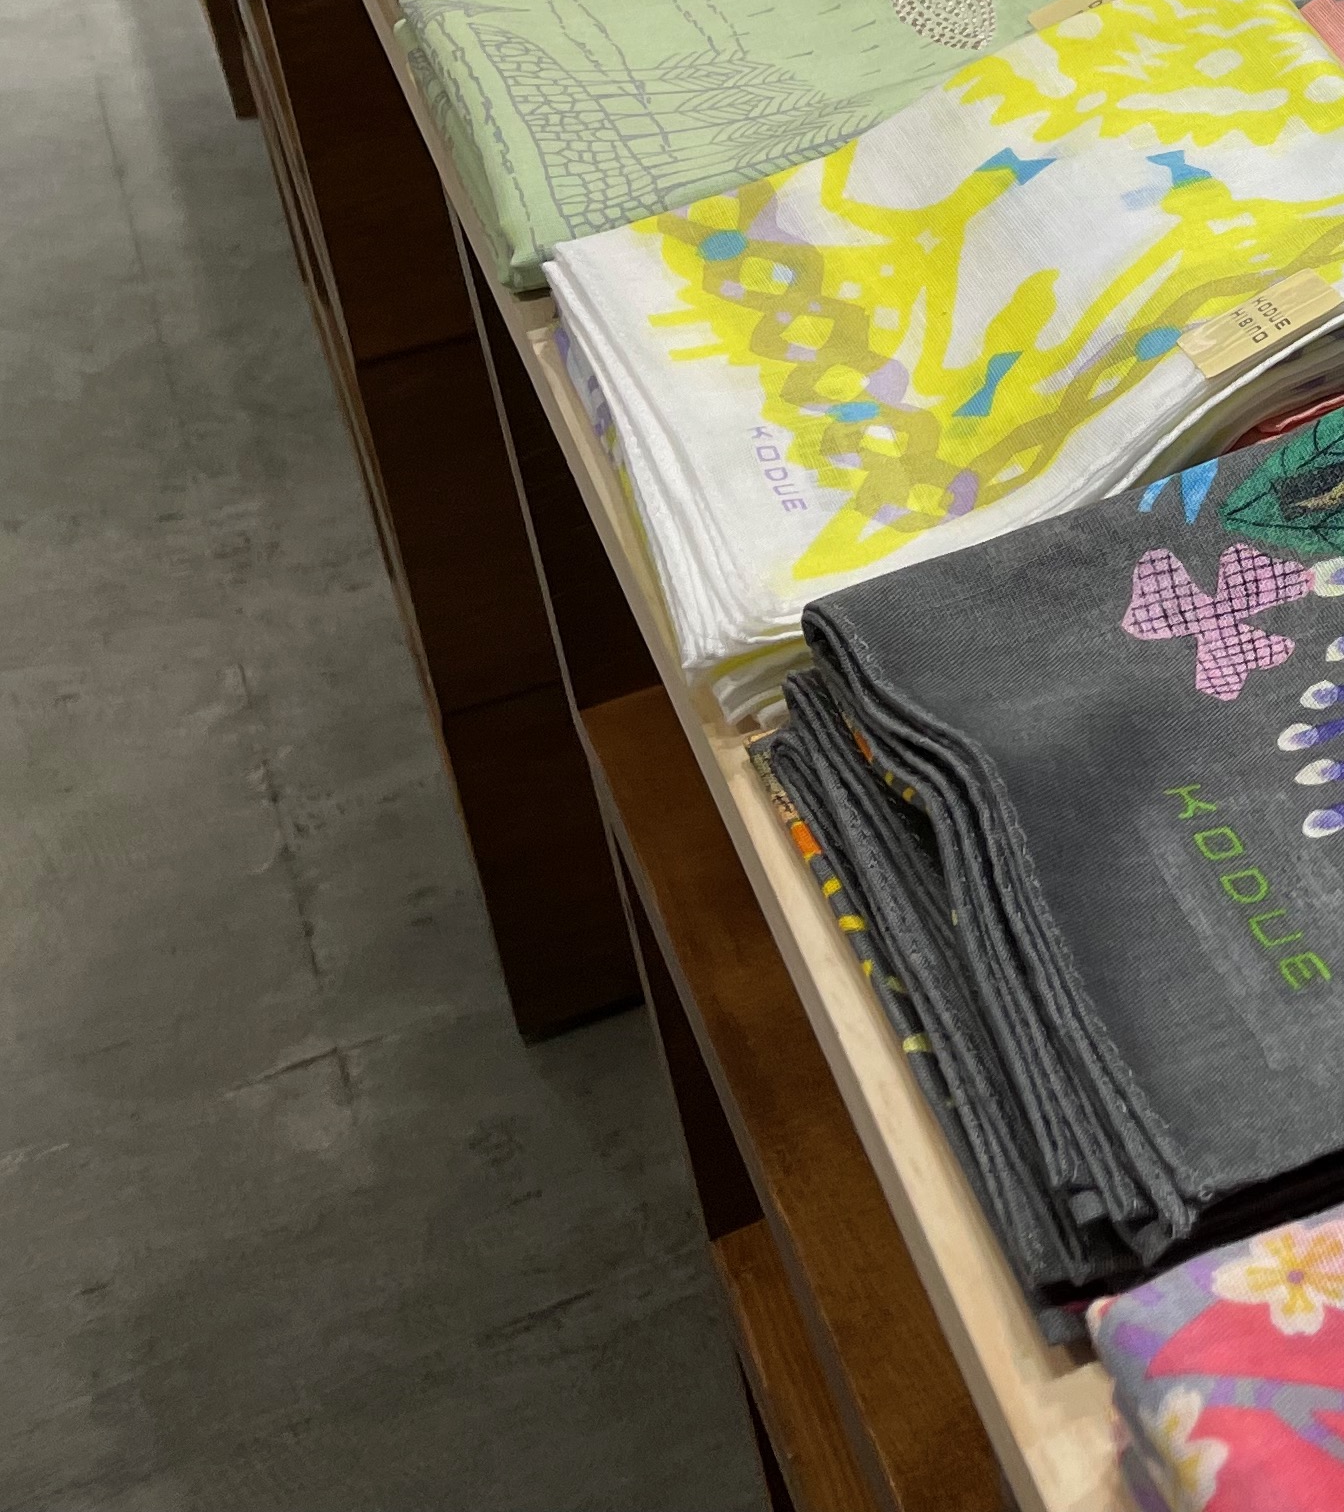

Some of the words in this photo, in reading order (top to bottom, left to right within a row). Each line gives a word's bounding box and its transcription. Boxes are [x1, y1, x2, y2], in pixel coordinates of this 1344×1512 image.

[1228, 308, 1269, 344] HIBINO
[1251, 295, 1292, 331] KODUE
[746, 425, 809, 513] KODUE
[1163, 782, 1334, 991] KODUE
